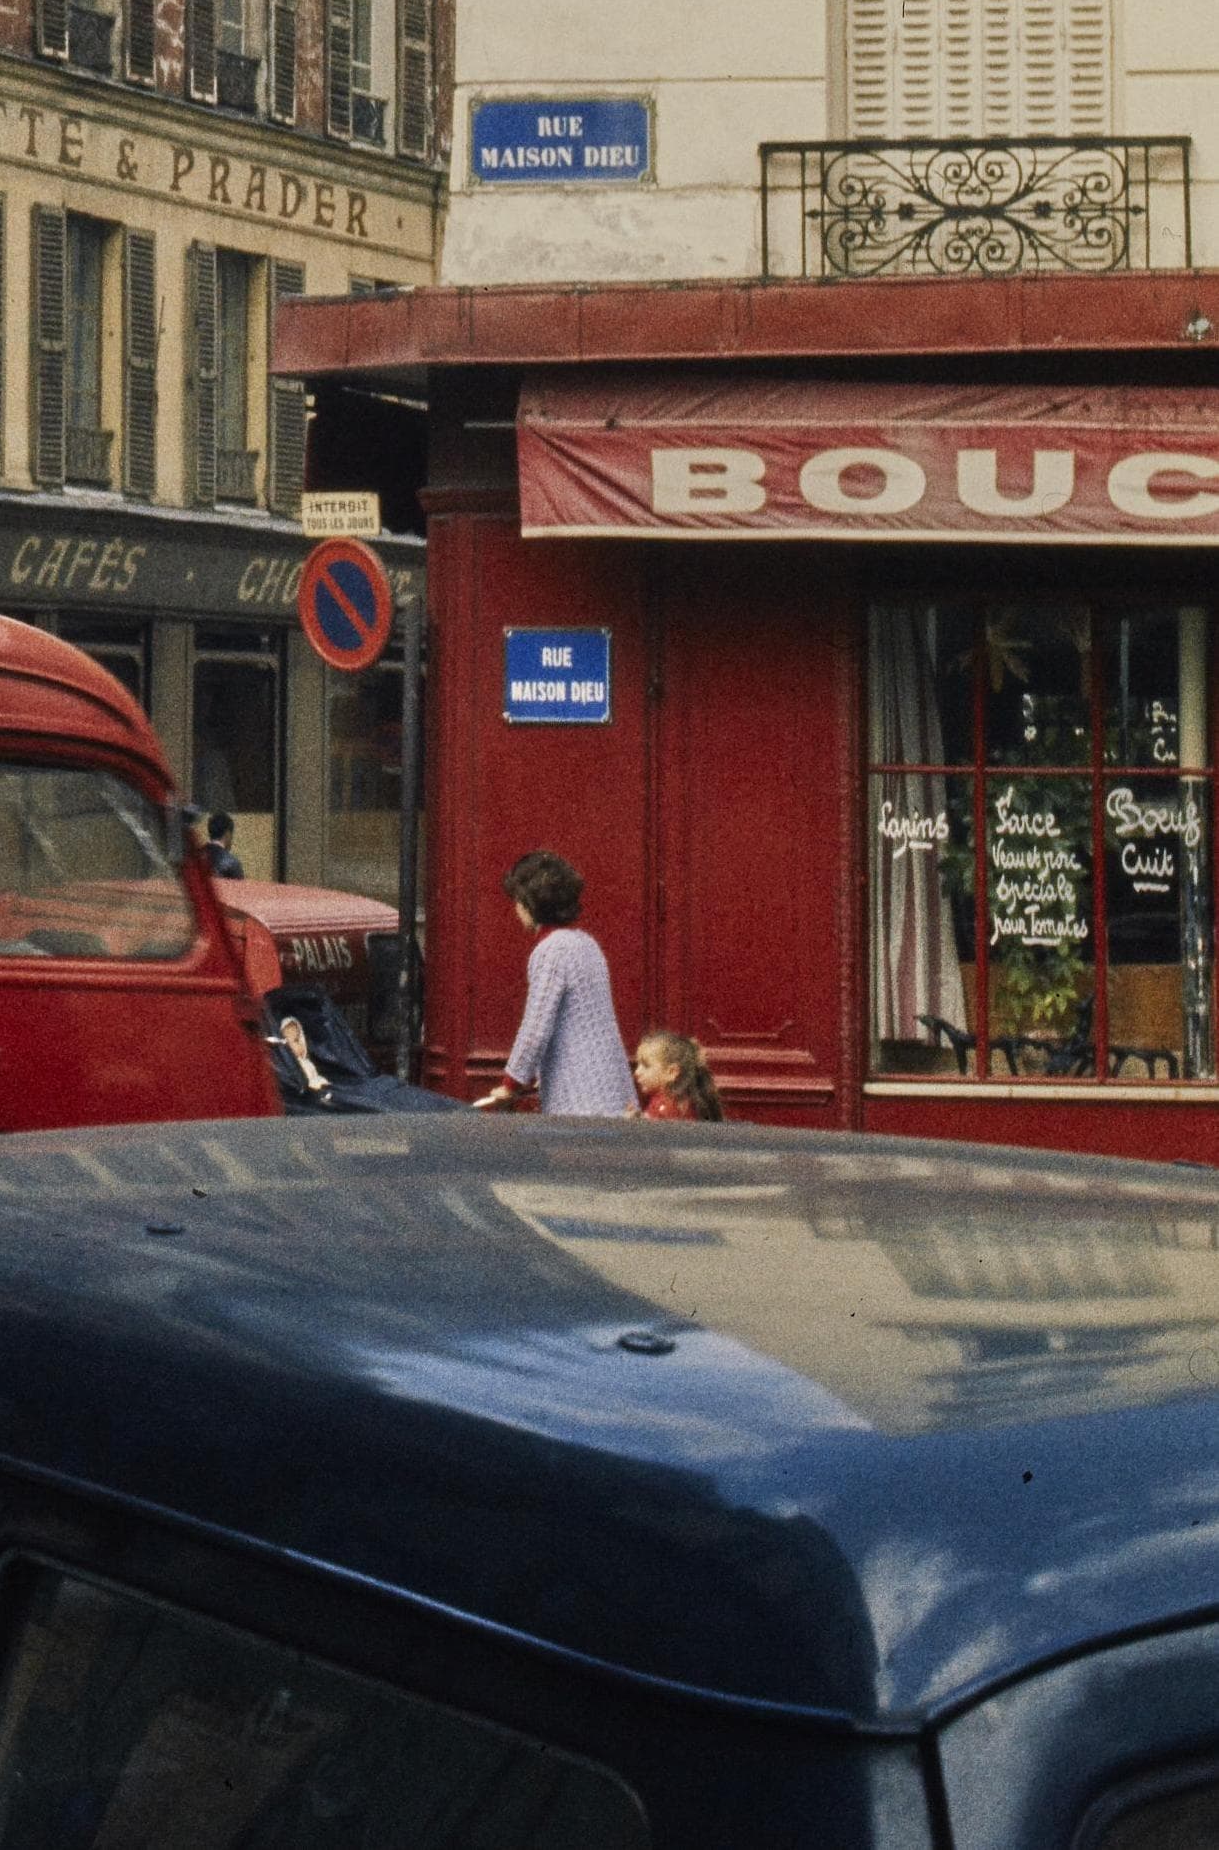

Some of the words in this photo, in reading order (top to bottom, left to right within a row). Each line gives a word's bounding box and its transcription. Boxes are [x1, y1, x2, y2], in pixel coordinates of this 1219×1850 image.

[537, 115, 583, 138] RUE
[481, 146, 573, 169] MAISON
[584, 145, 640, 168] DIEU
[115, 137, 139, 181] &
[170, 144, 370, 238] PRADER
[650, 447, 1219, 521] BOUC
[309, 499, 368, 514] INTERDIT
[306, 516, 327, 530] TOUS
[346, 516, 375, 530] JOURS
[541, 646, 573, 668] RUE
[510, 680, 567, 702] MAISON
[570, 680, 605, 704] DIEU
[878, 800, 950, 860] Lapins
[1121, 843, 1175, 877] Cuit
